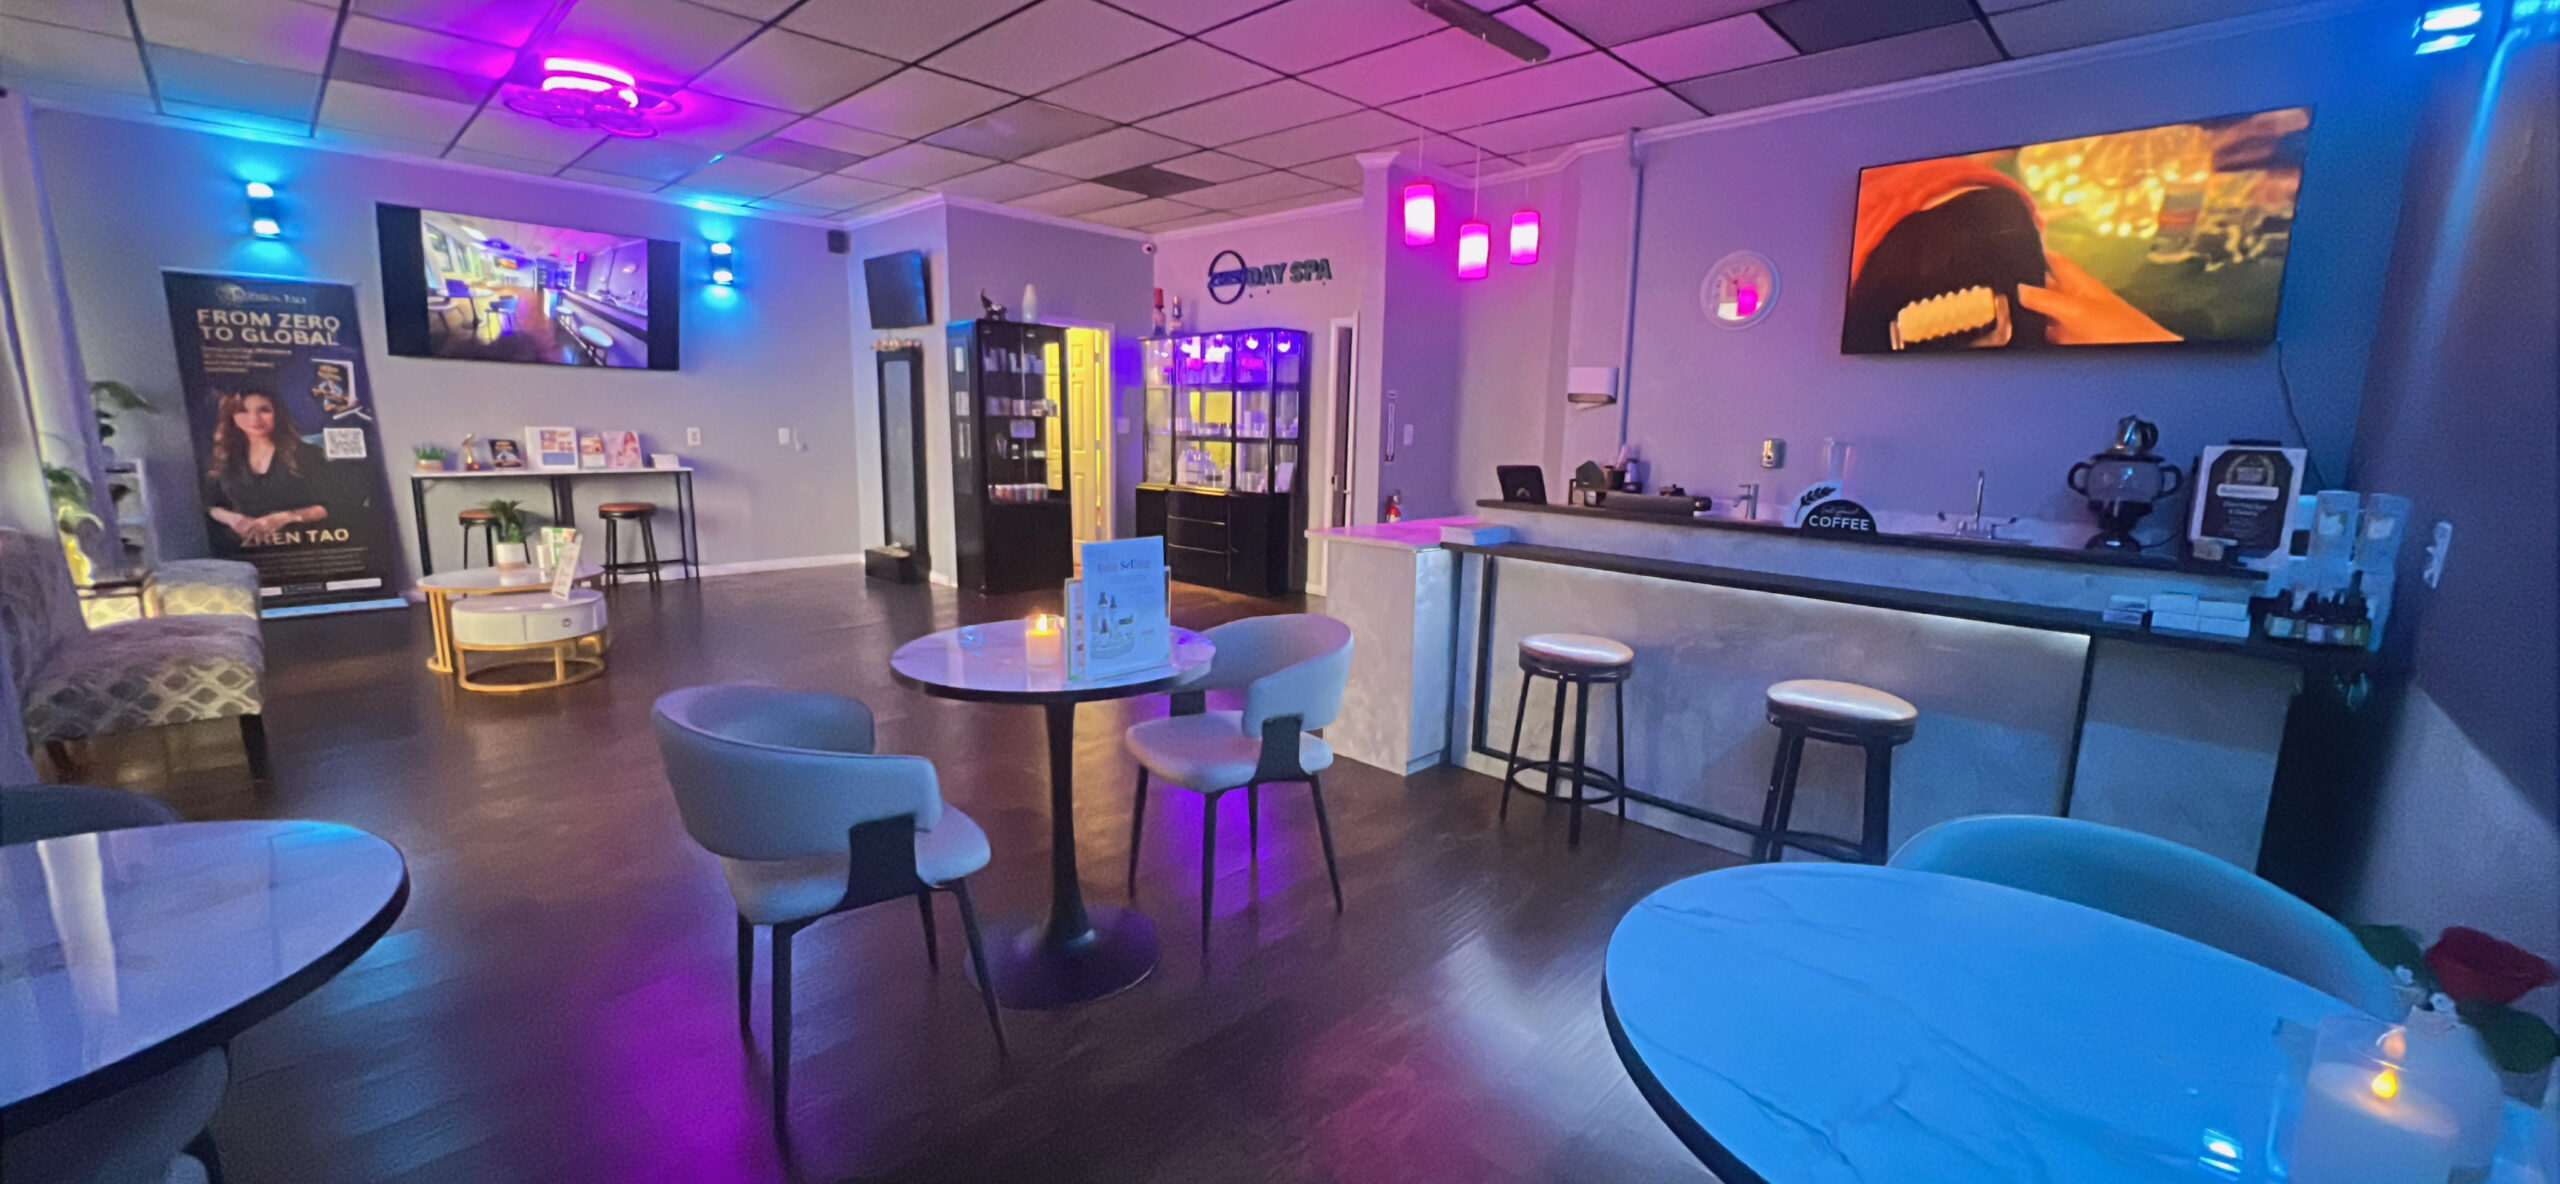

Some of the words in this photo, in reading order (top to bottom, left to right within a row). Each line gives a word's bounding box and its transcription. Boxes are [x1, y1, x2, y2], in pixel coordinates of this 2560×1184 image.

[1246, 262, 1288, 287] DAY
[1289, 258, 1332, 283] SPA
[197, 308, 271, 327] FROM
[277, 313, 340, 331] ZERO
[199, 325, 234, 341] TO
[241, 327, 340, 346] GLOBAL
[1808, 514, 1870, 531] COFFEE
[305, 528, 349, 543] TAO
